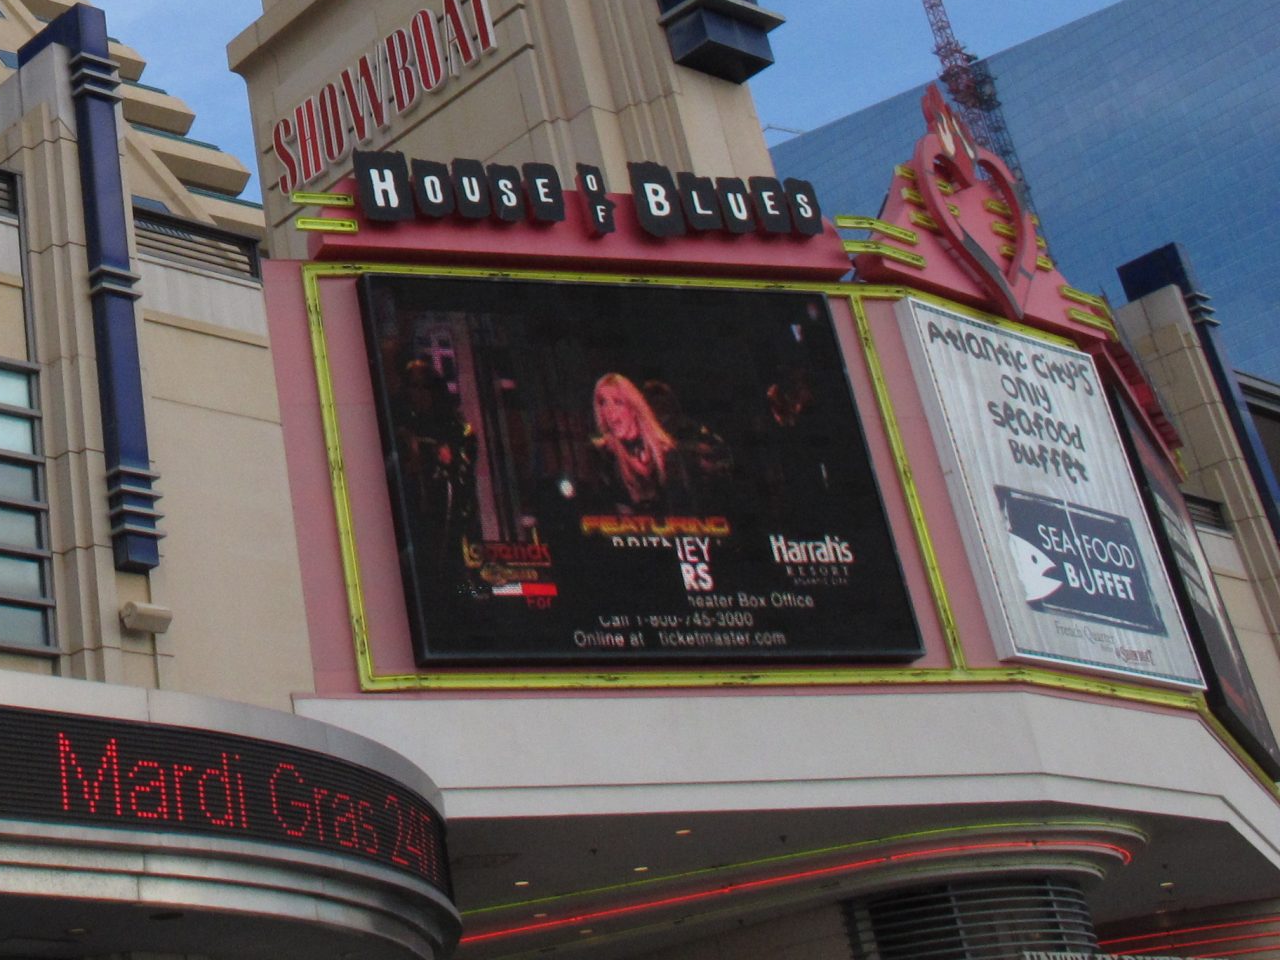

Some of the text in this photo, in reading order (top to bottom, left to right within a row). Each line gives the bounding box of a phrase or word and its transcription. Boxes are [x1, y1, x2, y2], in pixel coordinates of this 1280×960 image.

[367, 167, 556, 209] HOUSE
[642, 174, 814, 221] BLUES
[769, 534, 854, 563] Harrah's
[1062, 560, 1136, 601] BUFFET
[737, 592, 767, 608] Box
[770, 591, 816, 608] Office
[572, 629, 626, 648] Online
[629, 631, 646, 647] at
[57, 731, 249, 829] Mardi
[269, 762, 380, 855] Gras
